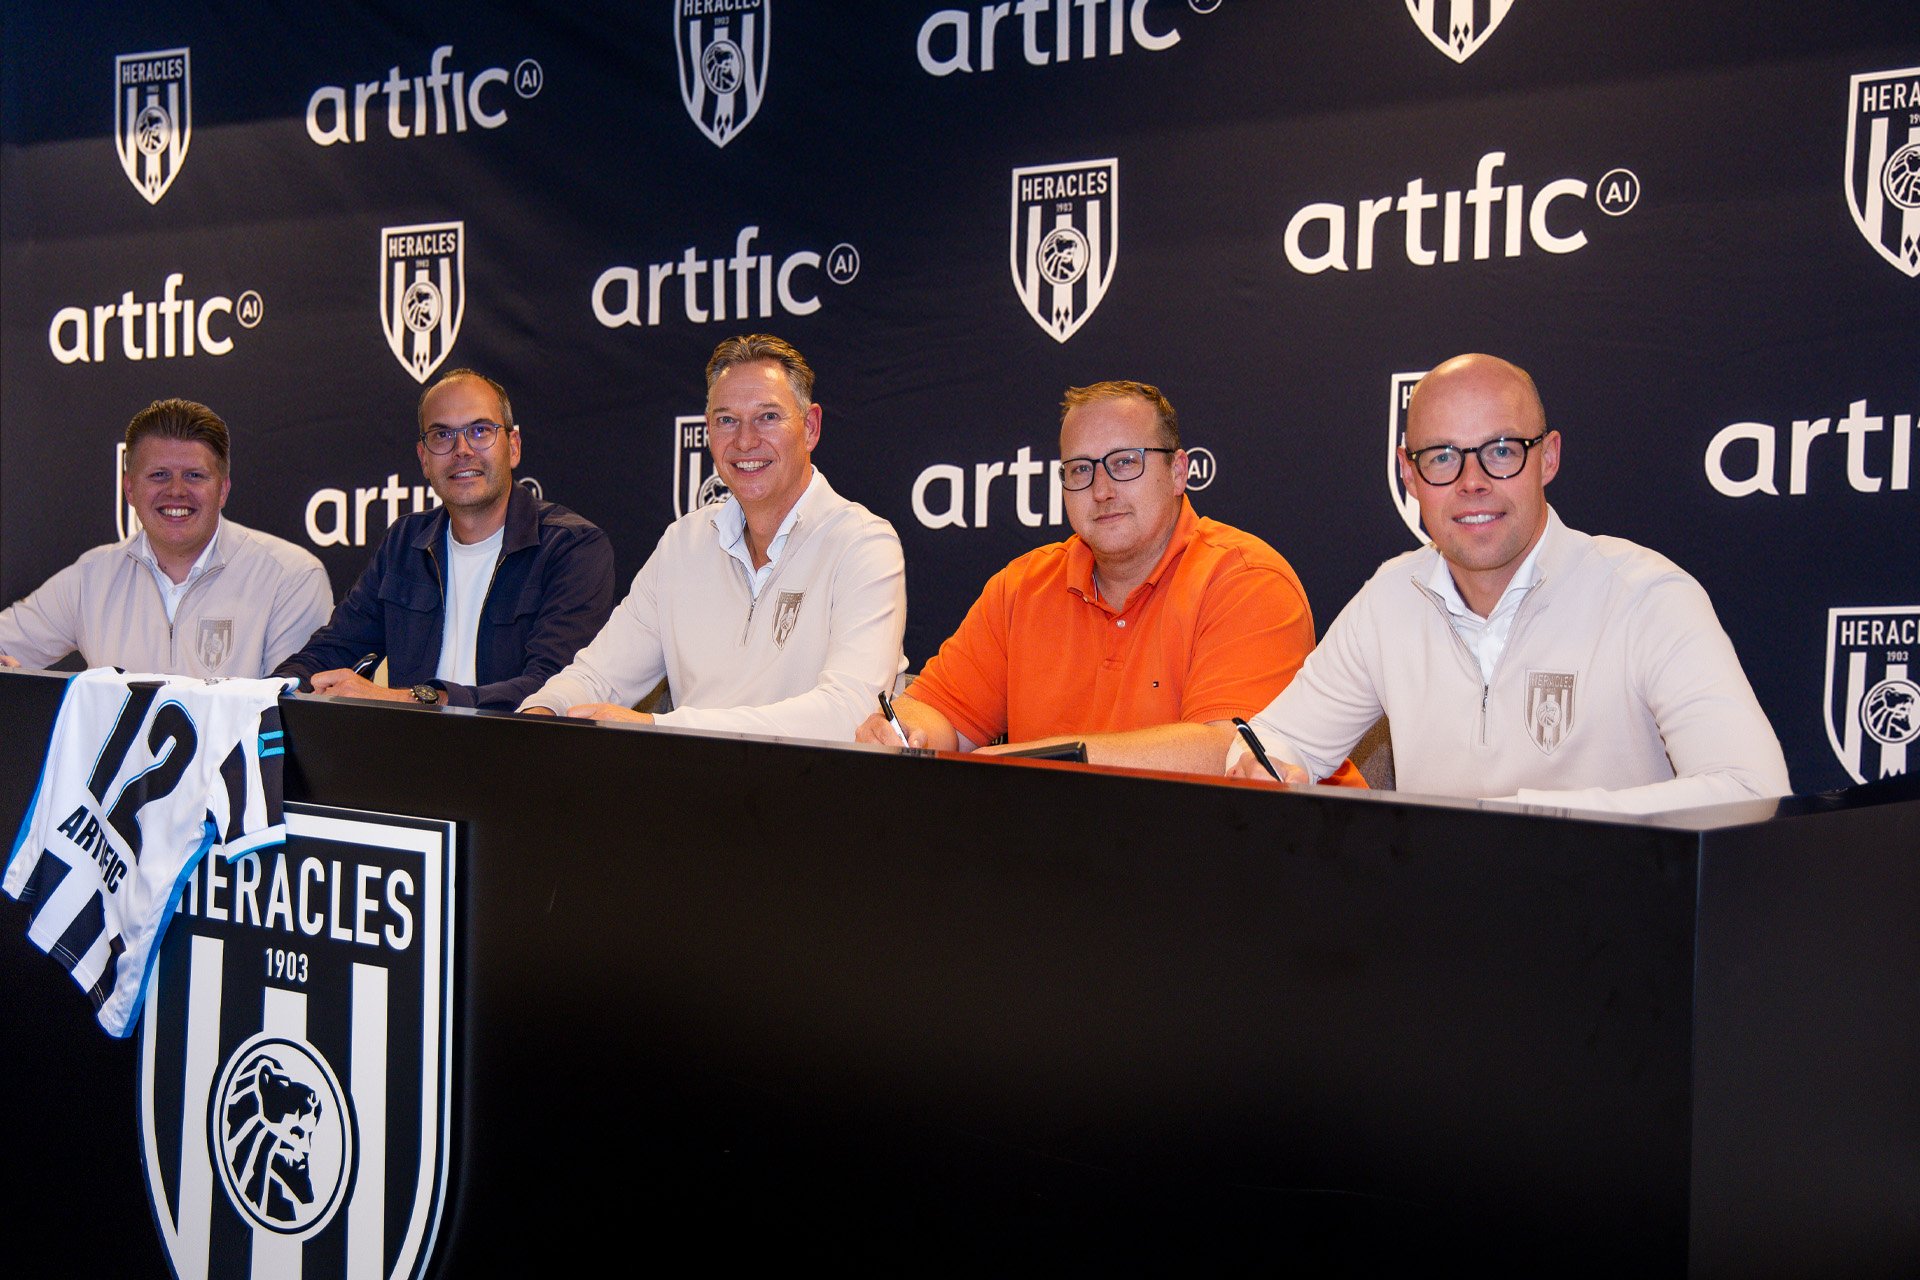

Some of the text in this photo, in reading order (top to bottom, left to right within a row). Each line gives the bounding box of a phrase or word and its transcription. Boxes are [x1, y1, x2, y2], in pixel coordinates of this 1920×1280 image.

[122, 58, 183, 84] HERACLES
[306, 45, 509, 146] artific
[1022, 171, 1108, 202] HERACLES
[1284, 152, 1588, 274] artific
[389, 232, 456, 258] HERACLES
[591, 226, 822, 328] artific
[49, 272, 234, 364] artific
[1704, 399, 1920, 498] arti
[265, 947, 309, 983] 1903
